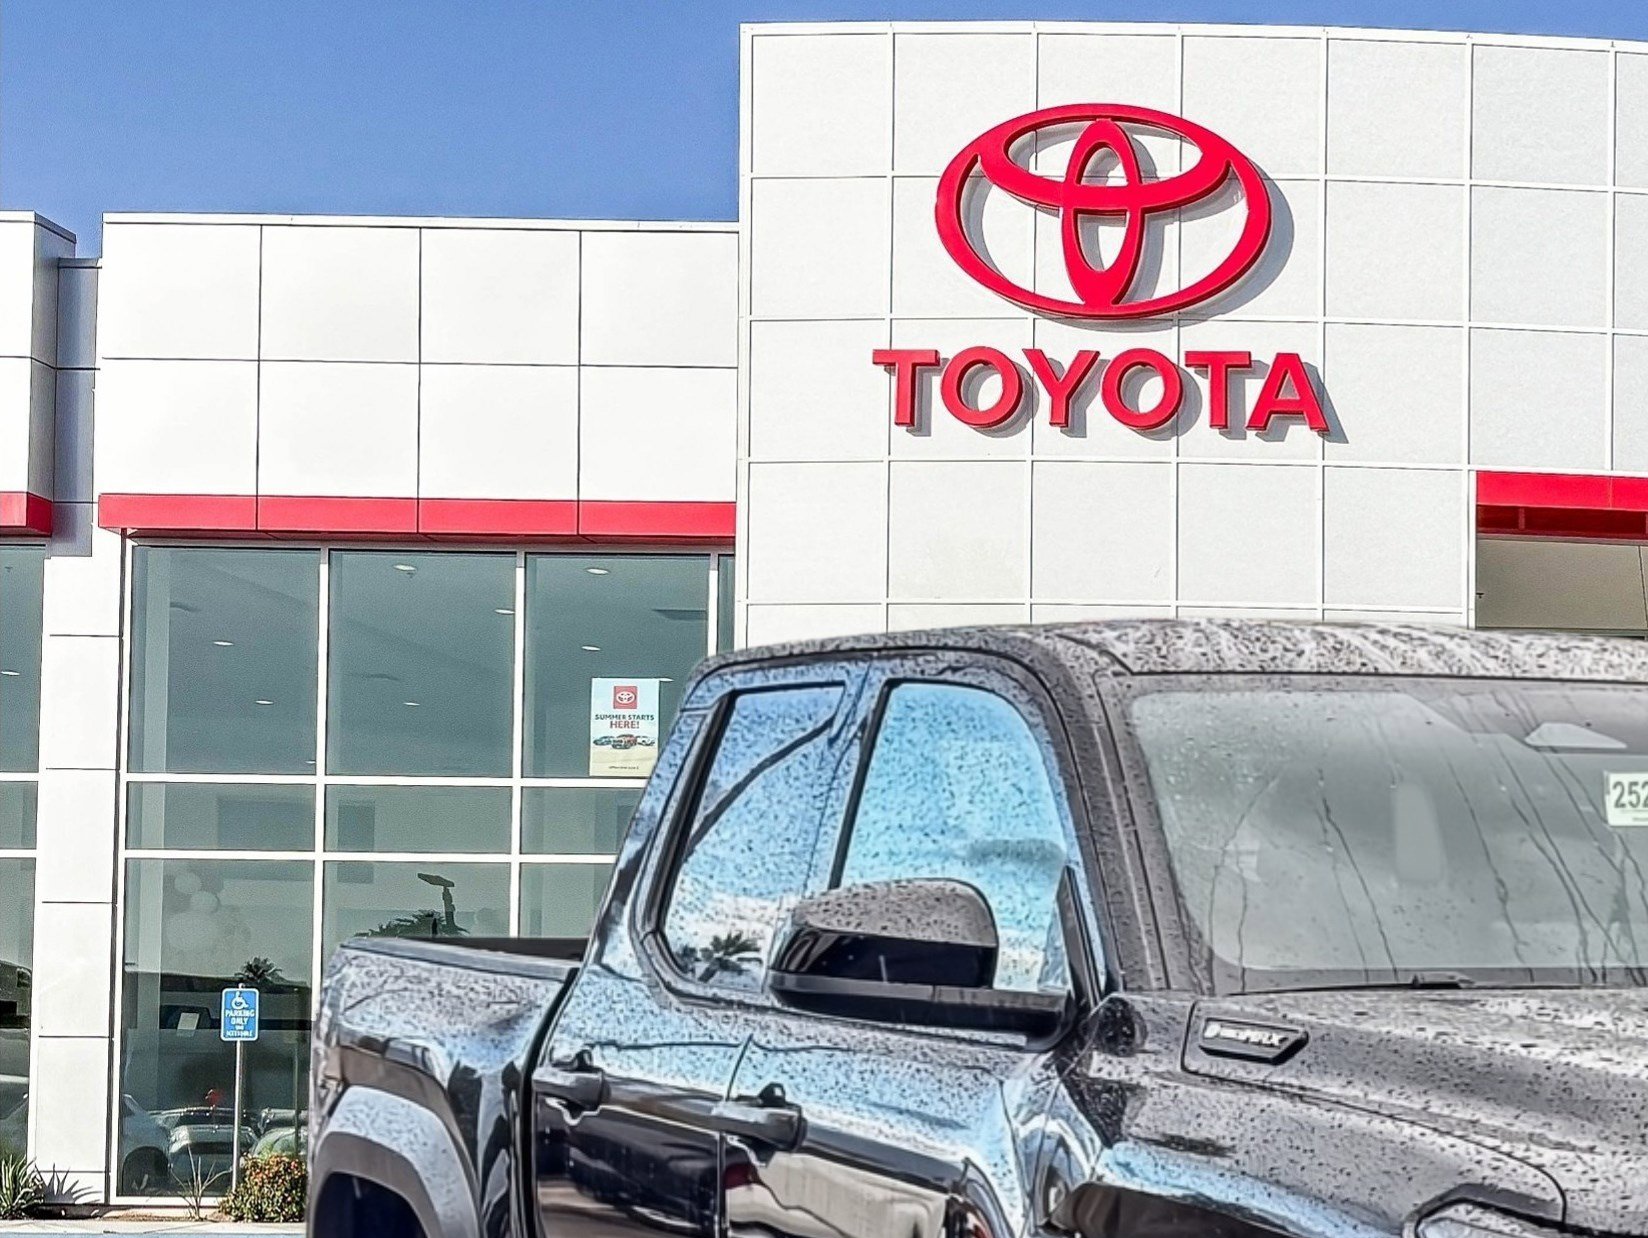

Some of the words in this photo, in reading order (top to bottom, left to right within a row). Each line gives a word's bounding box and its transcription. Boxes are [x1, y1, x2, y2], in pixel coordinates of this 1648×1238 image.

[872, 346, 1329, 433] TOYOTA
[609, 720, 640, 729] HERE!
[225, 1009, 255, 1017] PARKING
[230, 1017, 249, 1025] ONLY
